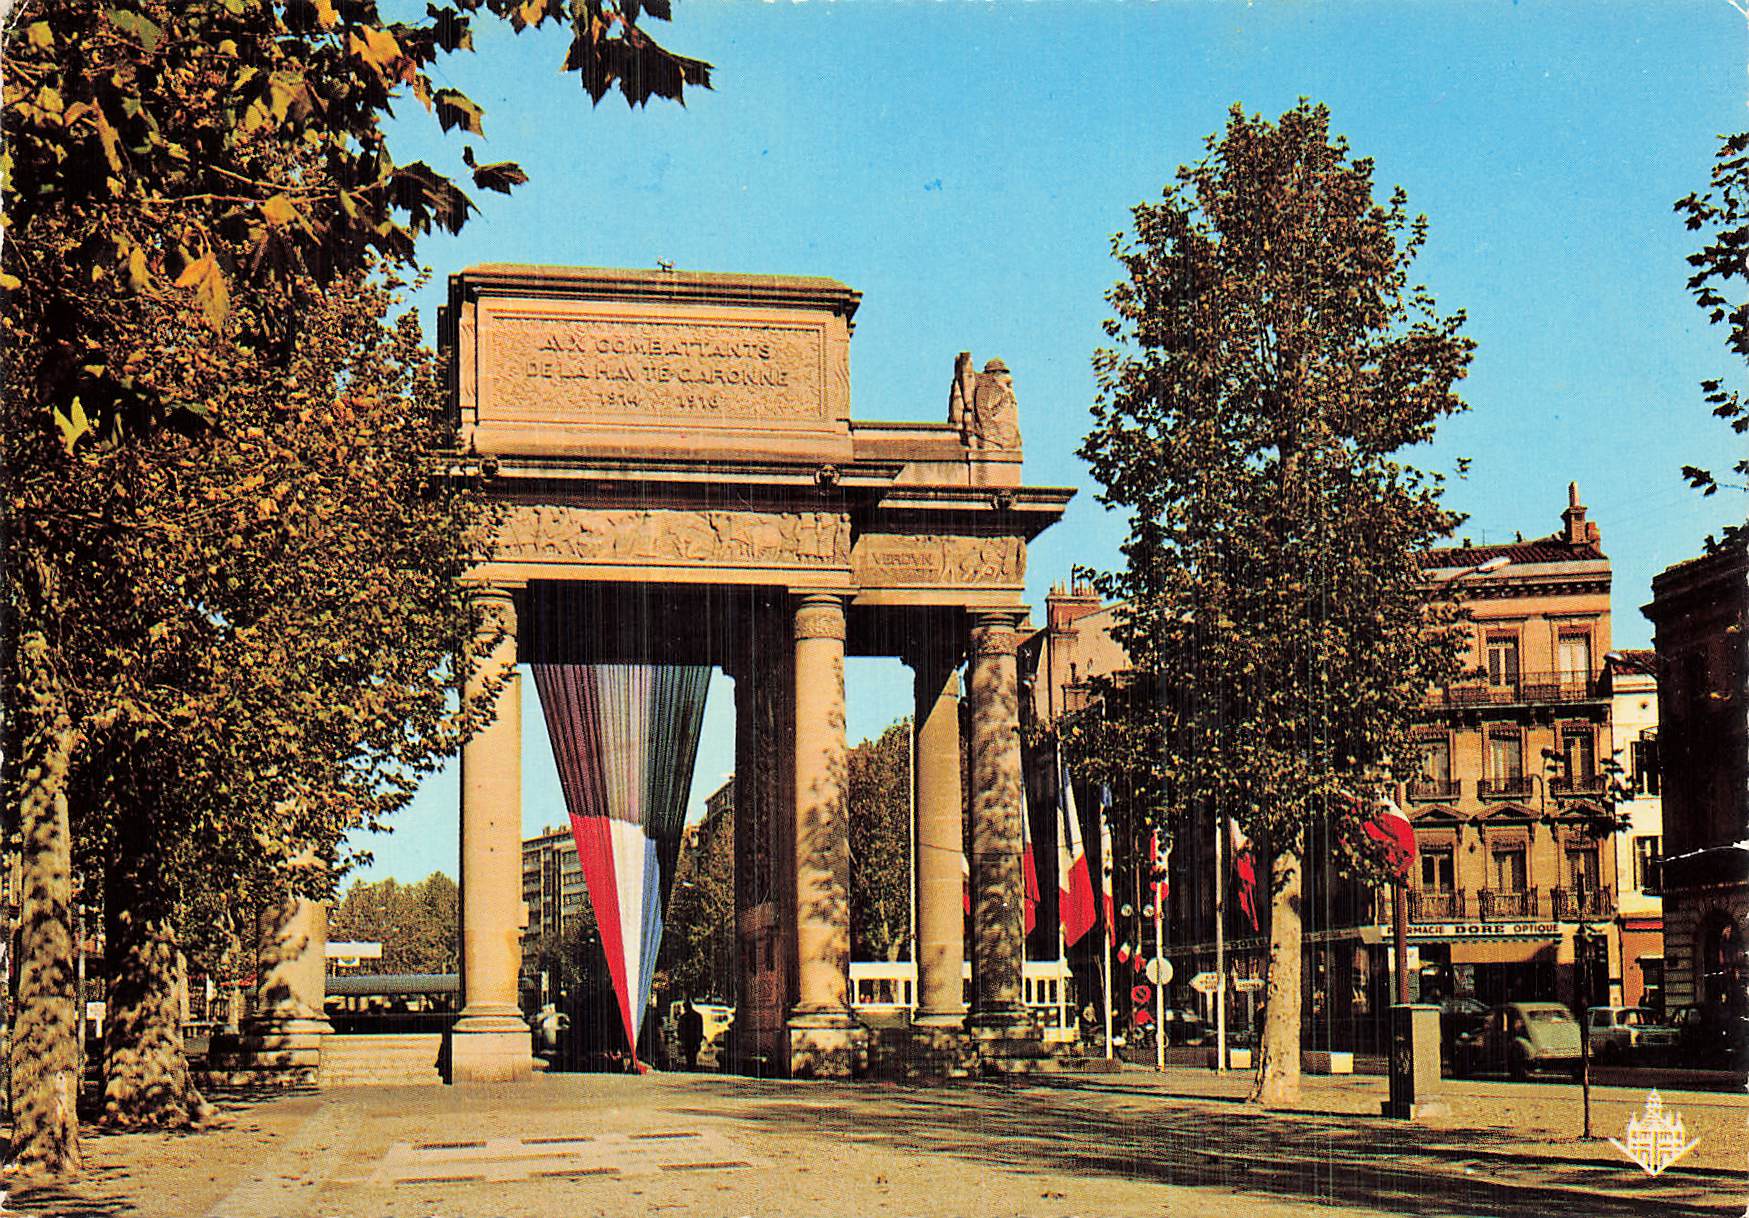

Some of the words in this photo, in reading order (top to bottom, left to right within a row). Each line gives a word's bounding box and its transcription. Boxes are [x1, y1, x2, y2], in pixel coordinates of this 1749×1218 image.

[594, 338, 770, 360] COMBATTANTS
[526, 361, 553, 379] DE
[559, 363, 590, 380] LA
[1387, 926, 1442, 935] PRMACIE
[1455, 925, 1505, 934] DORE
[1513, 924, 1559, 933] OPTIQUE
